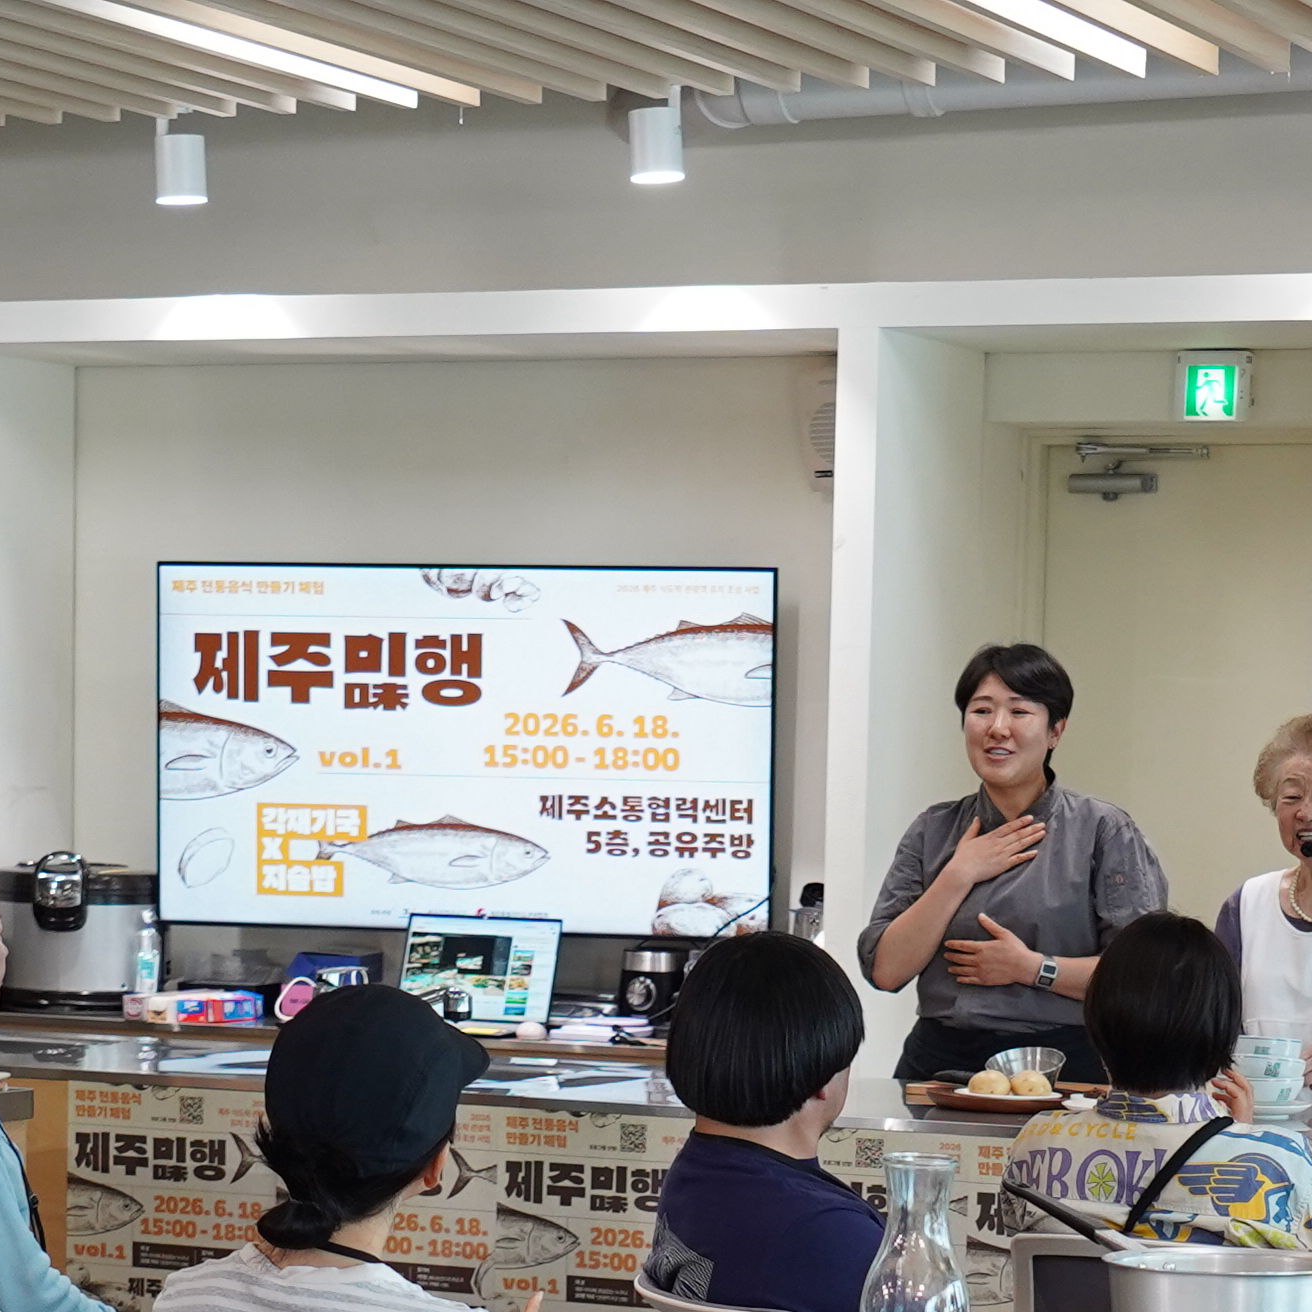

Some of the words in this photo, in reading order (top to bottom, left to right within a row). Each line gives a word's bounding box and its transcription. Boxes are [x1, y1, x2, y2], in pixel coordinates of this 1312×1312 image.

[172, 579, 197, 593] 제주
[201, 580, 253, 594] 전통음식
[256, 580, 295, 594] 만들기
[504, 712, 589, 736] 2026.
[596, 714, 624, 737] 6.
[633, 715, 679, 738] 18.
[318, 748, 402, 770] vol.1
[484, 745, 569, 768] 15:00
[594, 747, 680, 771] 18:00
[539, 794, 753, 825] 제주소통협력센터
[586, 830, 640, 858] 5층,
[647, 831, 755, 860] 공유주방
[75, 1089, 97, 1102] 제주
[99, 1091, 142, 1106] 전통음식
[75, 1105, 108, 1119] 만들기
[506, 1115, 530, 1129] 제주
[531, 1117, 579, 1134] 전통음식
[506, 1132, 541, 1147] 만들기
[543, 1134, 568, 1149] 체험
[153, 1195, 211, 1216] 2026.
[214, 1199, 234, 1218] 6.
[140, 1217, 198, 1239] 15:00
[429, 1215, 451, 1234] 6.
[455, 1217, 488, 1236] 18.
[590, 1227, 652, 1248] 2026.
[73, 1243, 127, 1260] vol.1
[427, 1238, 490, 1260] 18:00
[575, 1250, 637, 1272] 15:00
[502, 1276, 560, 1294] vol.1
